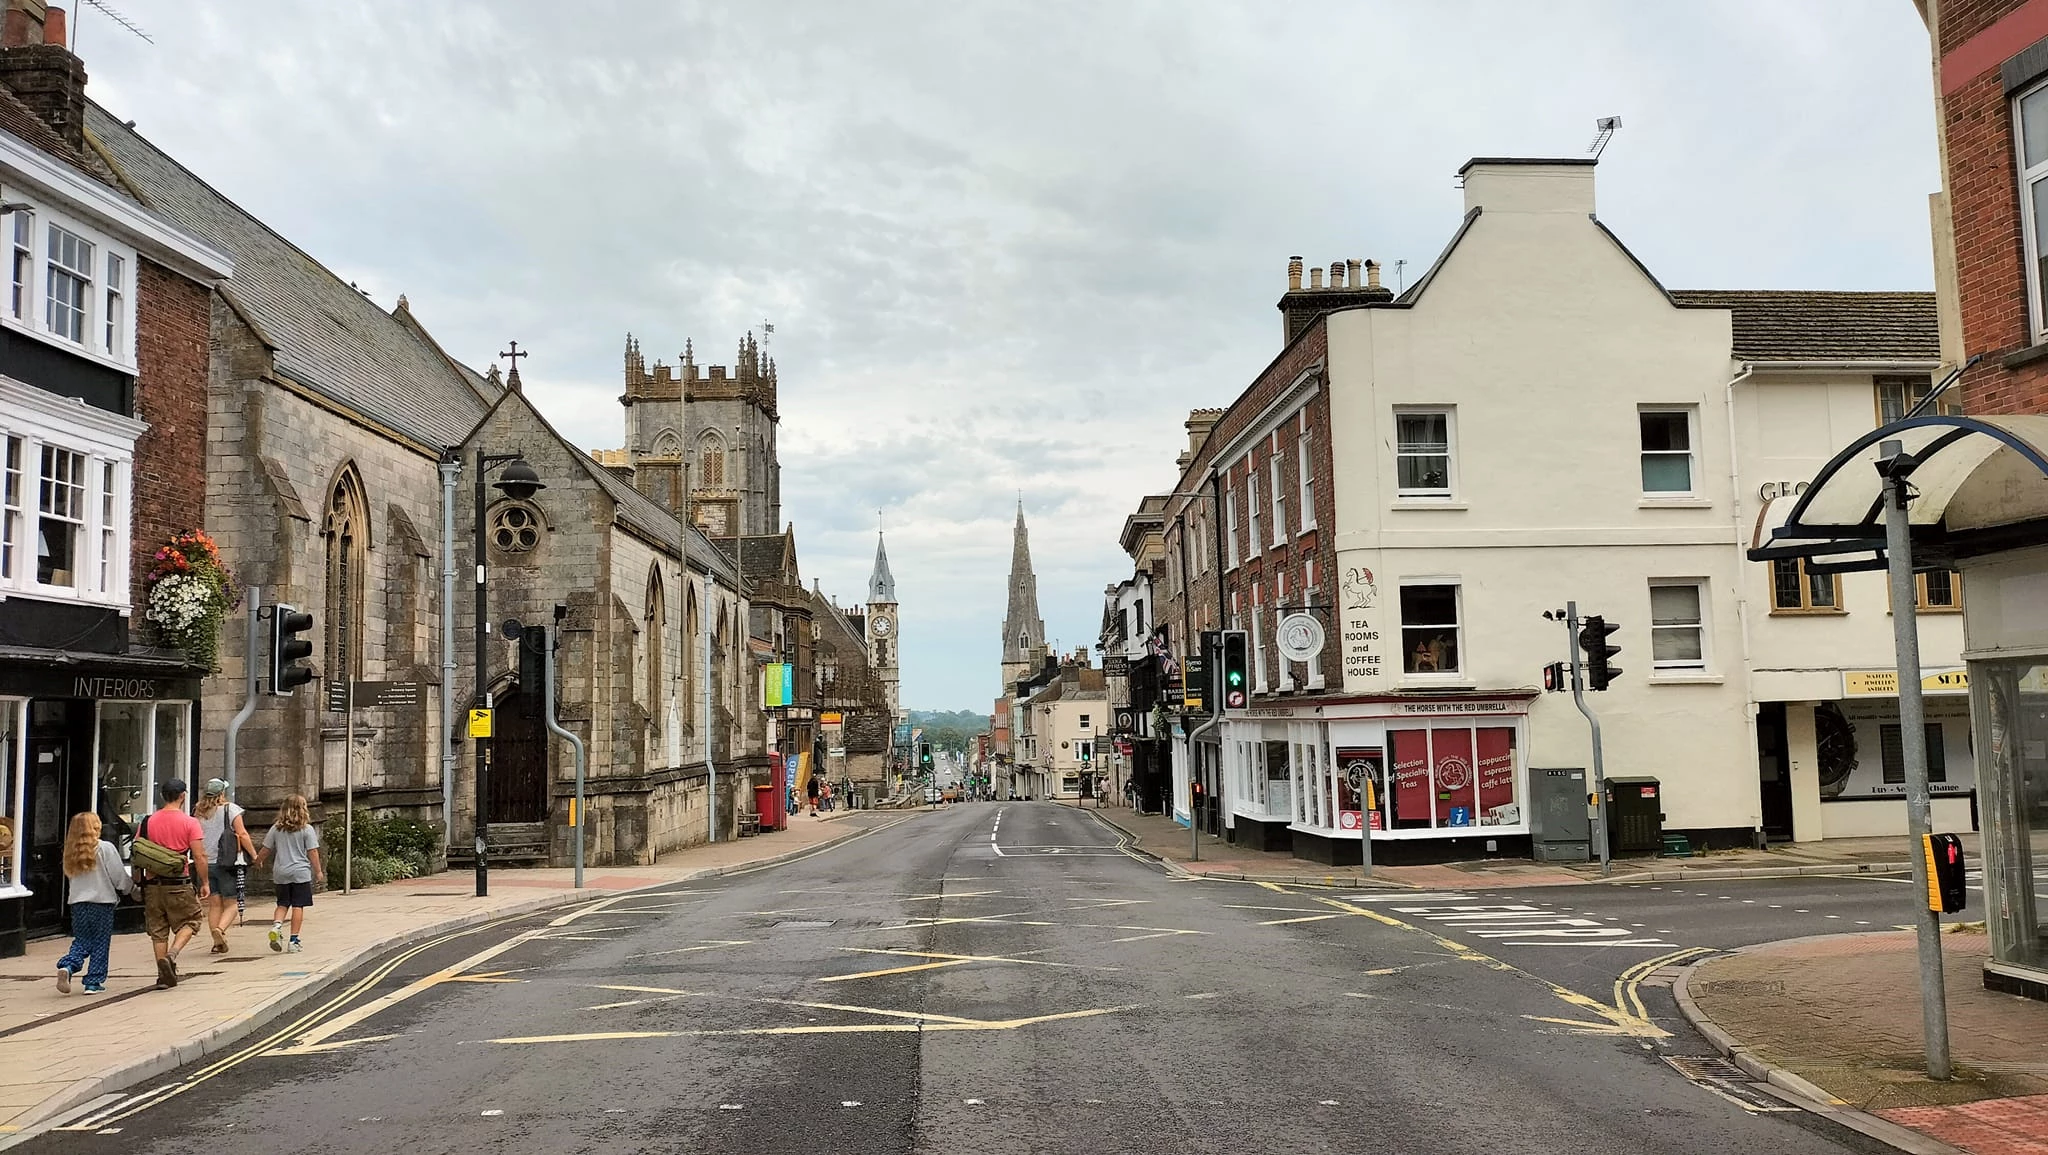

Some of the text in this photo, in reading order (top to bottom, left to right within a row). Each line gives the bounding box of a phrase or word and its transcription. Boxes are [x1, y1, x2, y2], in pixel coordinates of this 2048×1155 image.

[1350, 620, 1368, 628] TEA
[1345, 632, 1379, 640] ROOMS
[1352, 644, 1368, 652] and
[1345, 655, 1381, 665] COFFEE
[1347, 667, 1380, 677] HOUSE
[73, 677, 155, 698] INTERIORS
[1405, 704, 1416, 712] THE
[1416, 704, 1435, 712] HORSE
[1436, 704, 1451, 712] WITH
[1464, 703, 1476, 711] RED
[1477, 703, 1506, 711] UMBRELLA
[1393, 760, 1424, 770] Selection
[1479, 754, 1511, 766] cappuccin
[1396, 768, 1430, 781] Speciality
[1484, 766, 1512, 776] espresso
[1401, 781, 1418, 789] Teas
[1481, 777, 1512, 789] caffe latt
[1929, 784, 1959, 792] change
